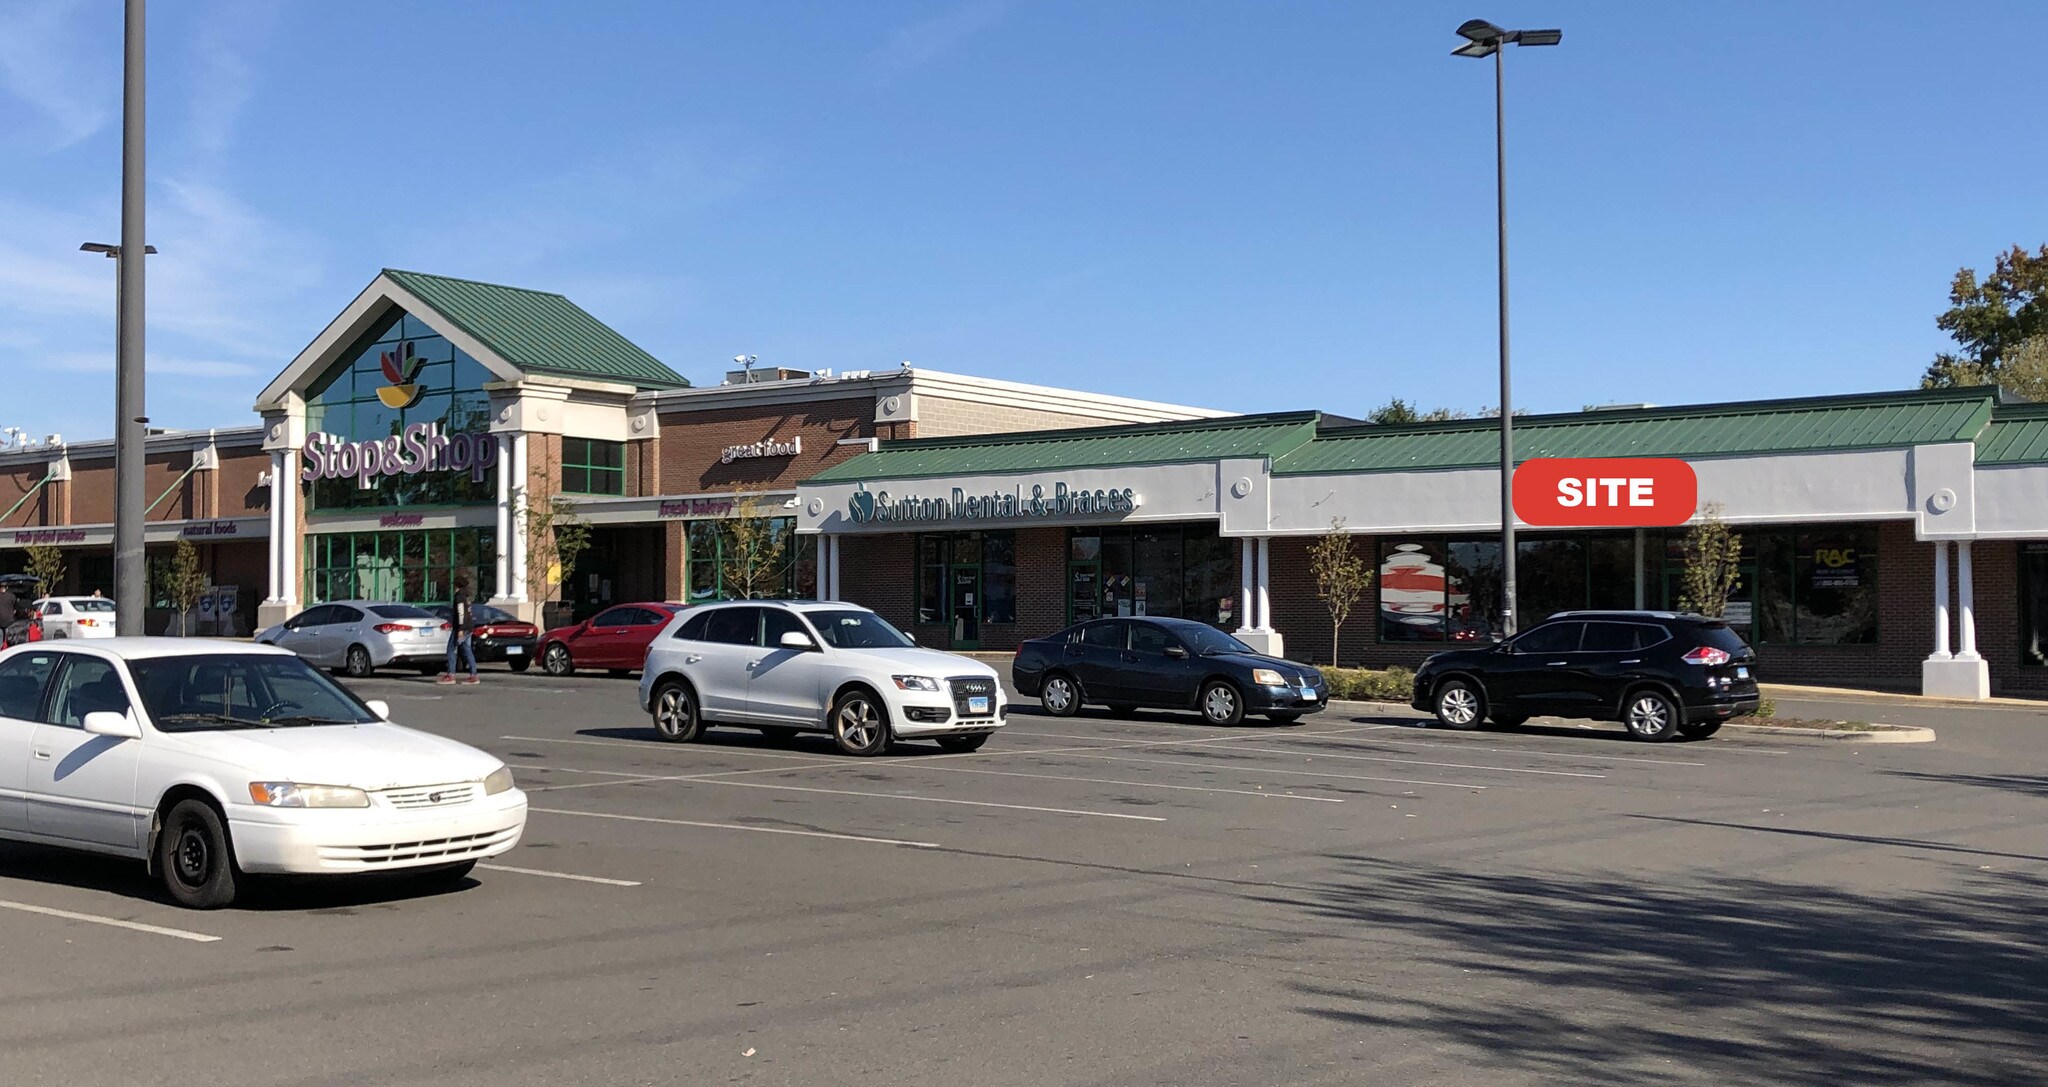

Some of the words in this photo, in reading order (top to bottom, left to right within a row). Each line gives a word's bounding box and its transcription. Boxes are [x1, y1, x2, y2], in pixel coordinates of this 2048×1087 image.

[302, 422, 500, 490] Stop&Shop
[721, 442, 762, 464] great
[763, 436, 801, 458] food
[659, 500, 689, 517] fresh
[691, 499, 733, 517] bakery
[876, 490, 949, 523] Sutton
[950, 484, 1023, 519] Dental
[1028, 484, 1048, 517] &
[1054, 481, 1136, 516] Braces
[183, 522, 213, 536] natural
[214, 521, 237, 535] foods
